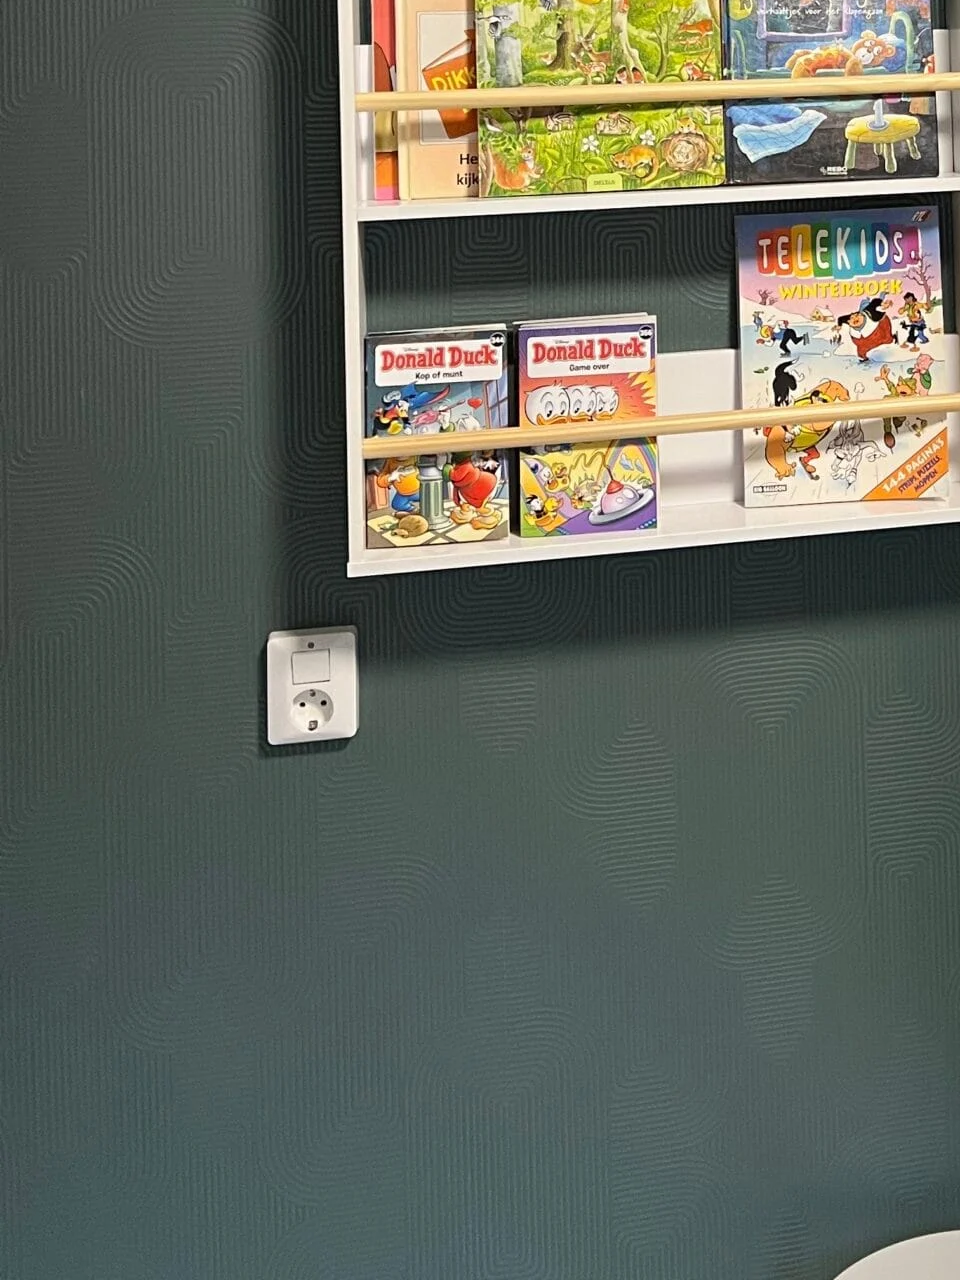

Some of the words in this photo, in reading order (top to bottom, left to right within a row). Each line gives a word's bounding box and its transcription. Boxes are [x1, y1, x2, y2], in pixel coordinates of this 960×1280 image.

[778, 279, 904, 300] WINTERBOEK
[381, 346, 446, 373] Donald
[447, 344, 498, 368] Duck
[532, 339, 596, 364] Donald
[597, 336, 646, 360] Duck
[415, 372, 431, 381] Kop
[432, 371, 441, 379] of
[569, 364, 591, 372] Game
[592, 363, 610, 371] over
[905, 437, 945, 474] PAGINAS
